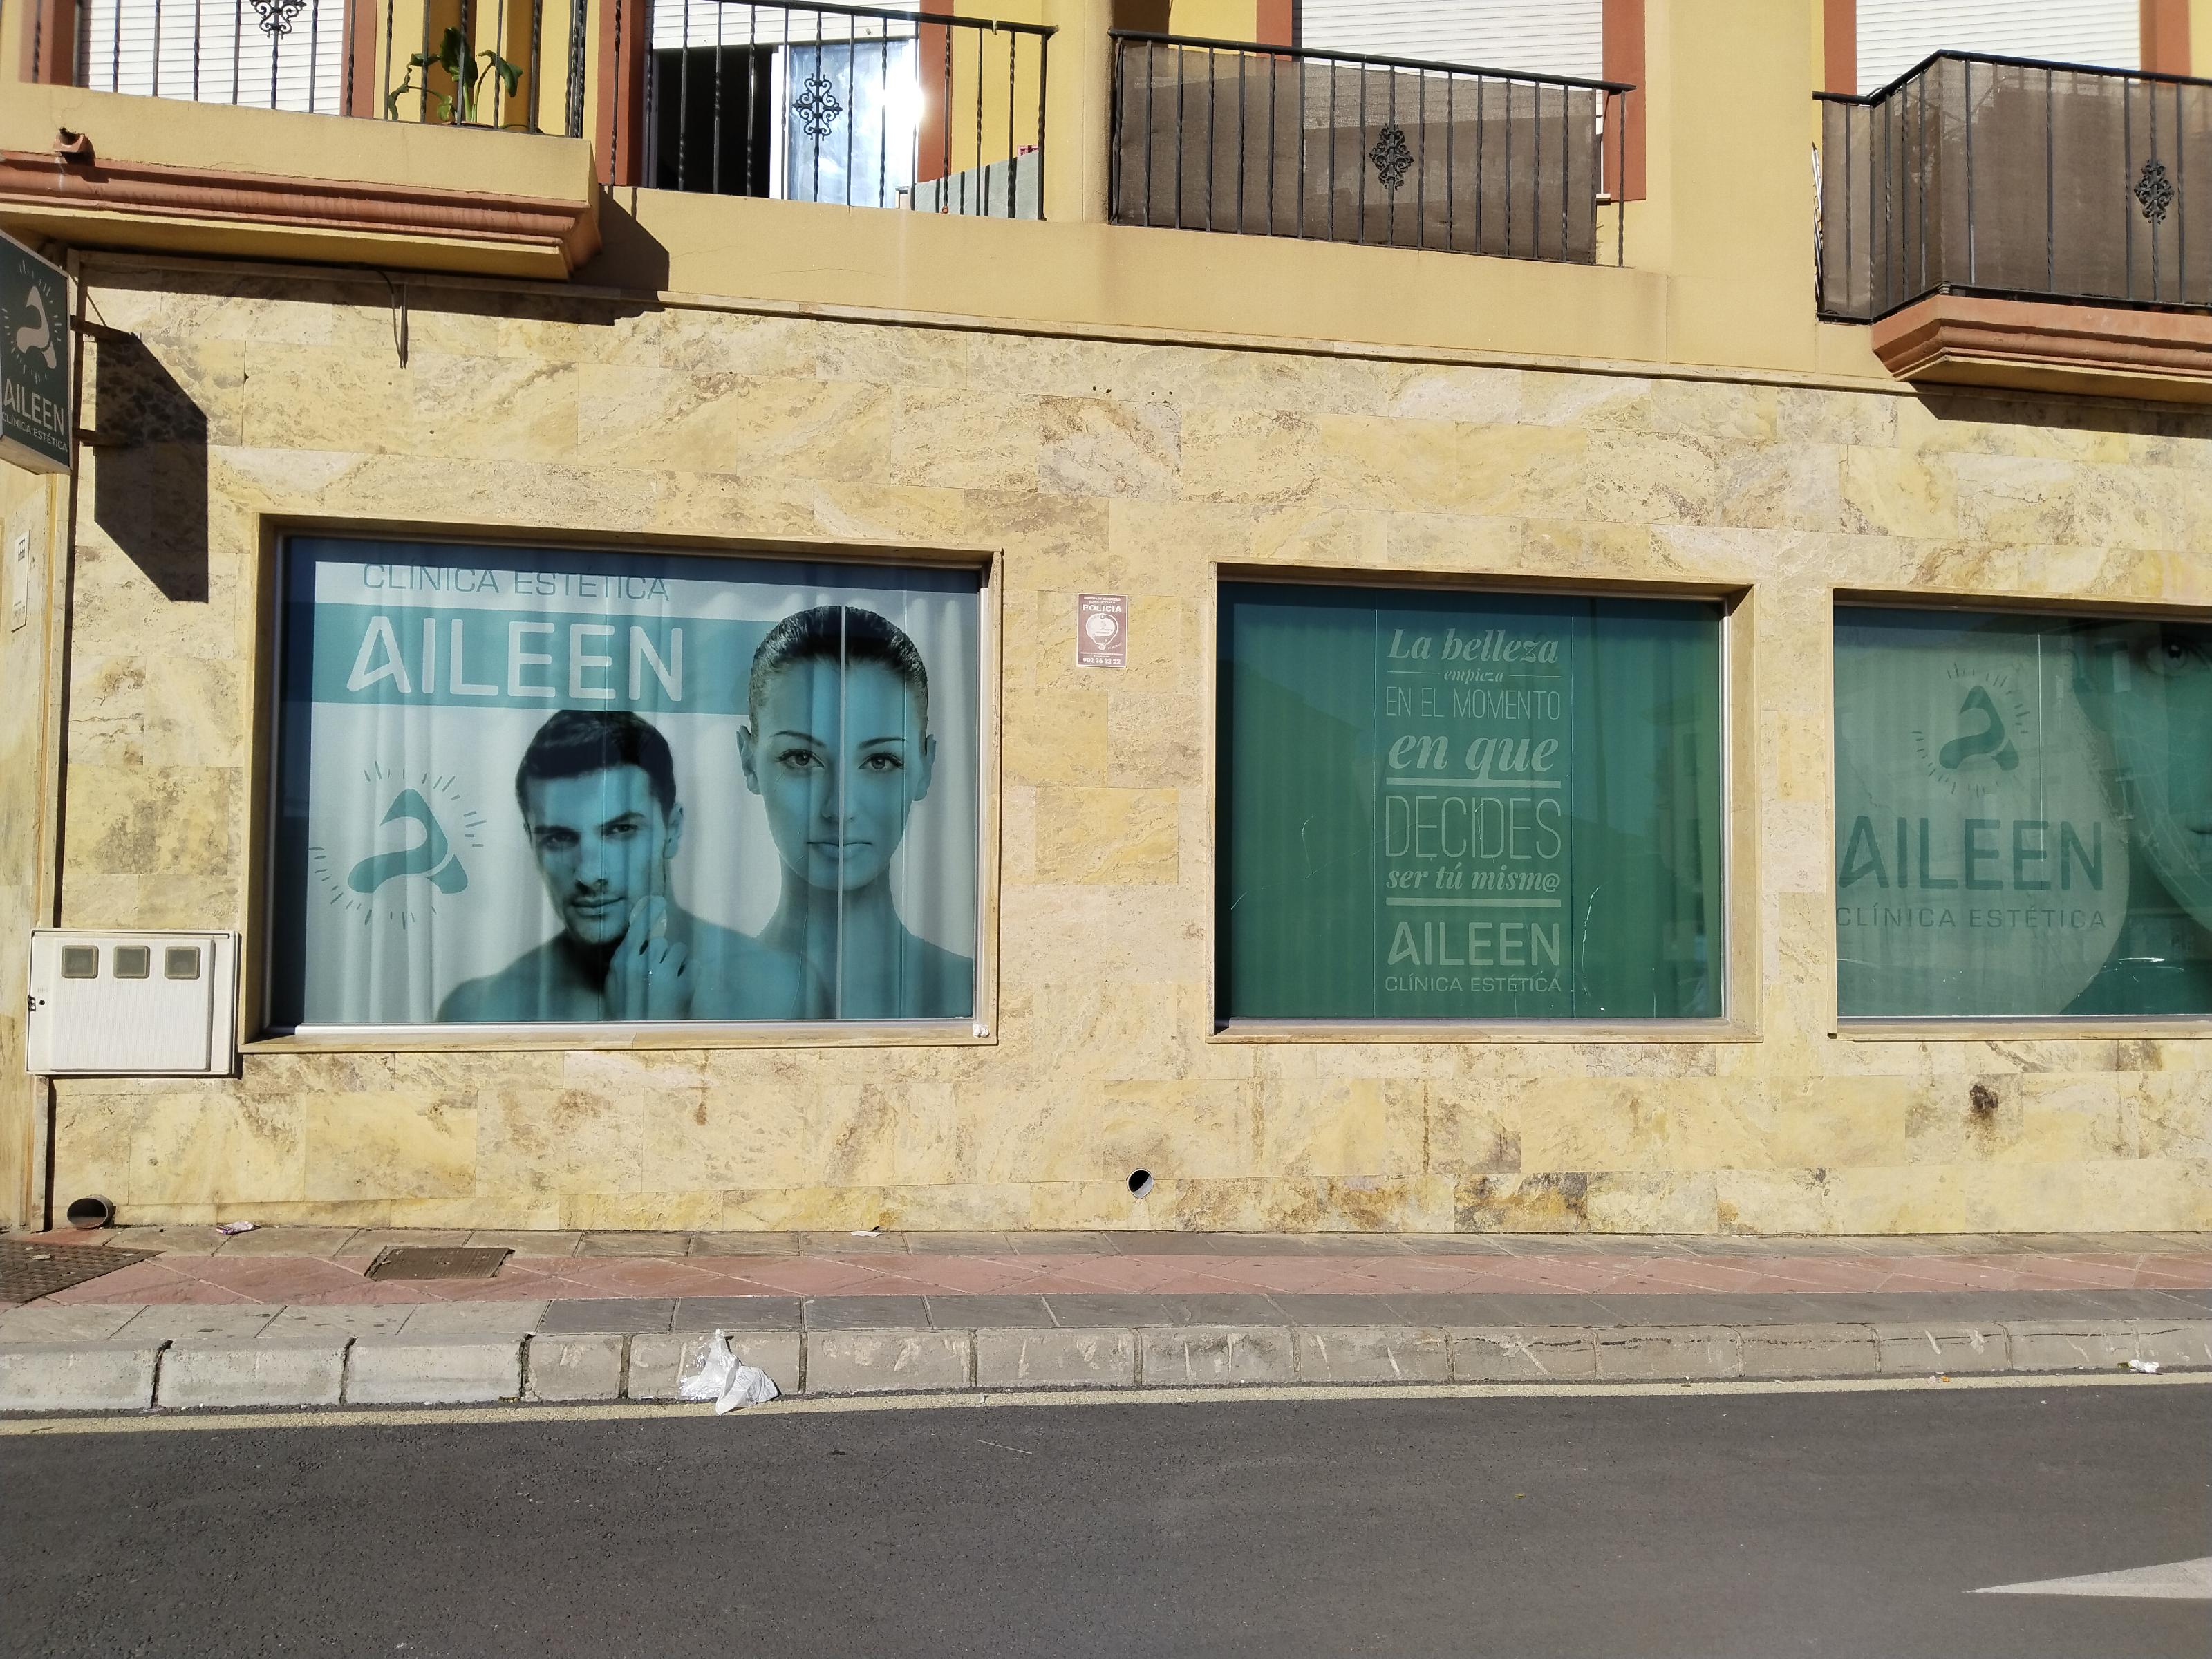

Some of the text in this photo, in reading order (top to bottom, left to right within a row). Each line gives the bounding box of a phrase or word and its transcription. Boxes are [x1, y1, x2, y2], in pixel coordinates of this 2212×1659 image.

[3, 378, 64, 435] AILEEN
[33, 428, 68, 452] ESTÉTICA
[364, 559, 499, 593] CLÍNICA
[1082, 604, 1122, 612] POLICIA
[346, 615, 684, 702] AILEEN
[1387, 628, 1559, 664] La belleza
[1443, 668, 1503, 684] empieza
[1386, 686, 1561, 720] EN EL MOMENTO
[1388, 735, 1559, 782] en que
[1385, 796, 1562, 859] DECIDES
[1839, 816, 2103, 892] AILEEN
[1386, 862, 1561, 893] ser tú mism@
[1836, 902, 2106, 928] CLÍNICA ESTÉTICA
[1387, 921, 1560, 966] AILEEN
[1385, 973, 1562, 991] CLÍNICA ESTÉTICA
